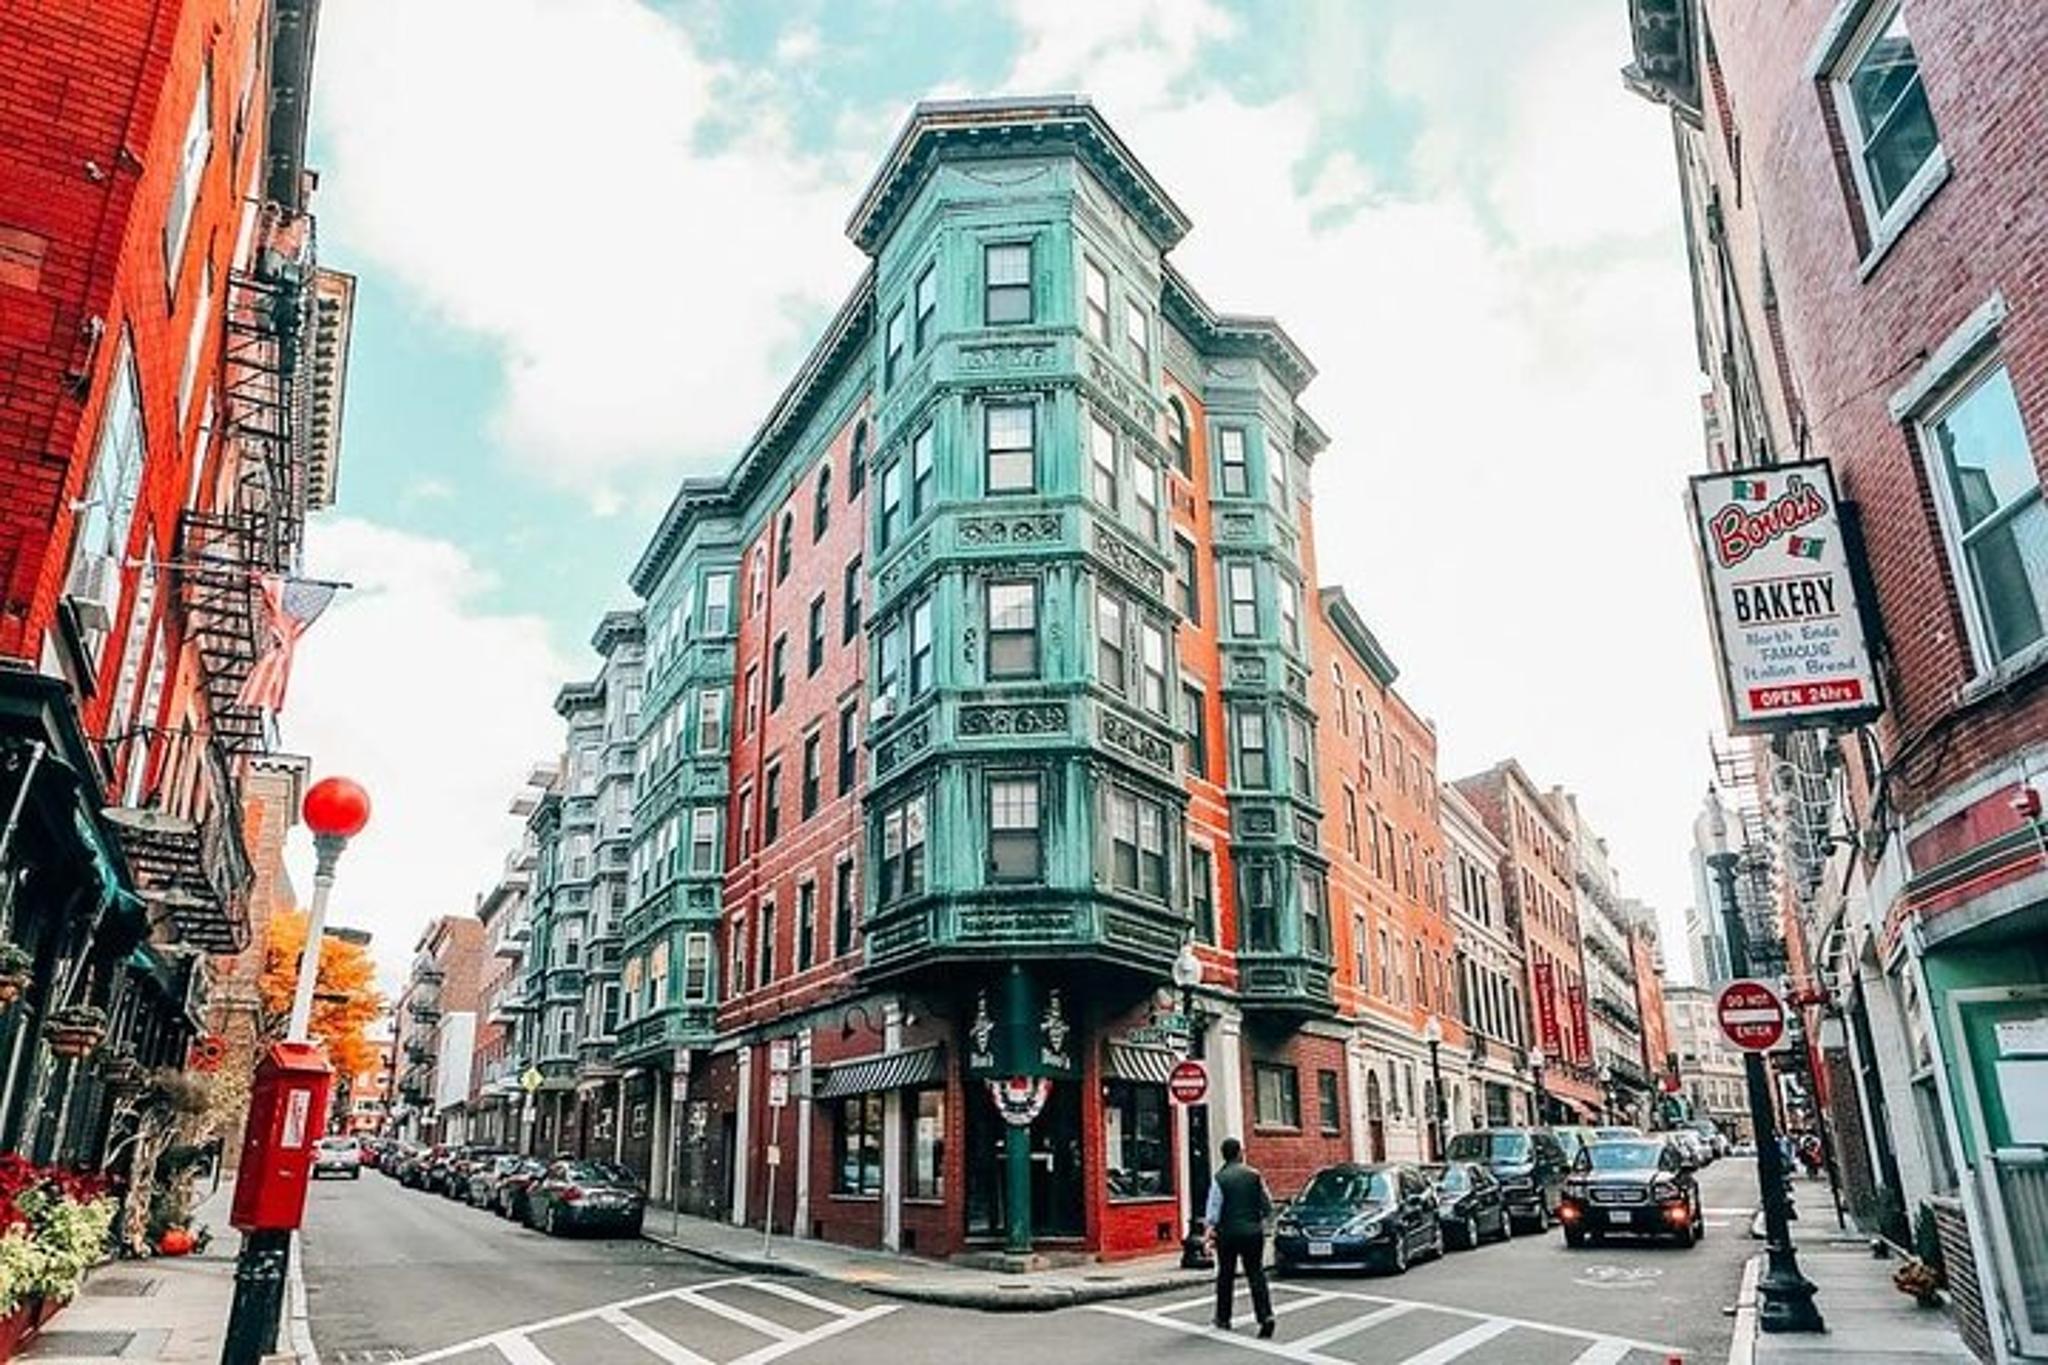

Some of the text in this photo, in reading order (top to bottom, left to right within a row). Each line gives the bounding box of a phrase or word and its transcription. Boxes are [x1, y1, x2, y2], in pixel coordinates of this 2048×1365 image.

[1711, 475, 1827, 567] Bova's
[1732, 577, 1835, 622] BAKERY
[1746, 629, 1793, 646] North
[1743, 656, 1855, 681] Italian Bread
[1761, 688, 1802, 707] OPEN
[1726, 994, 1744, 1008] DO
